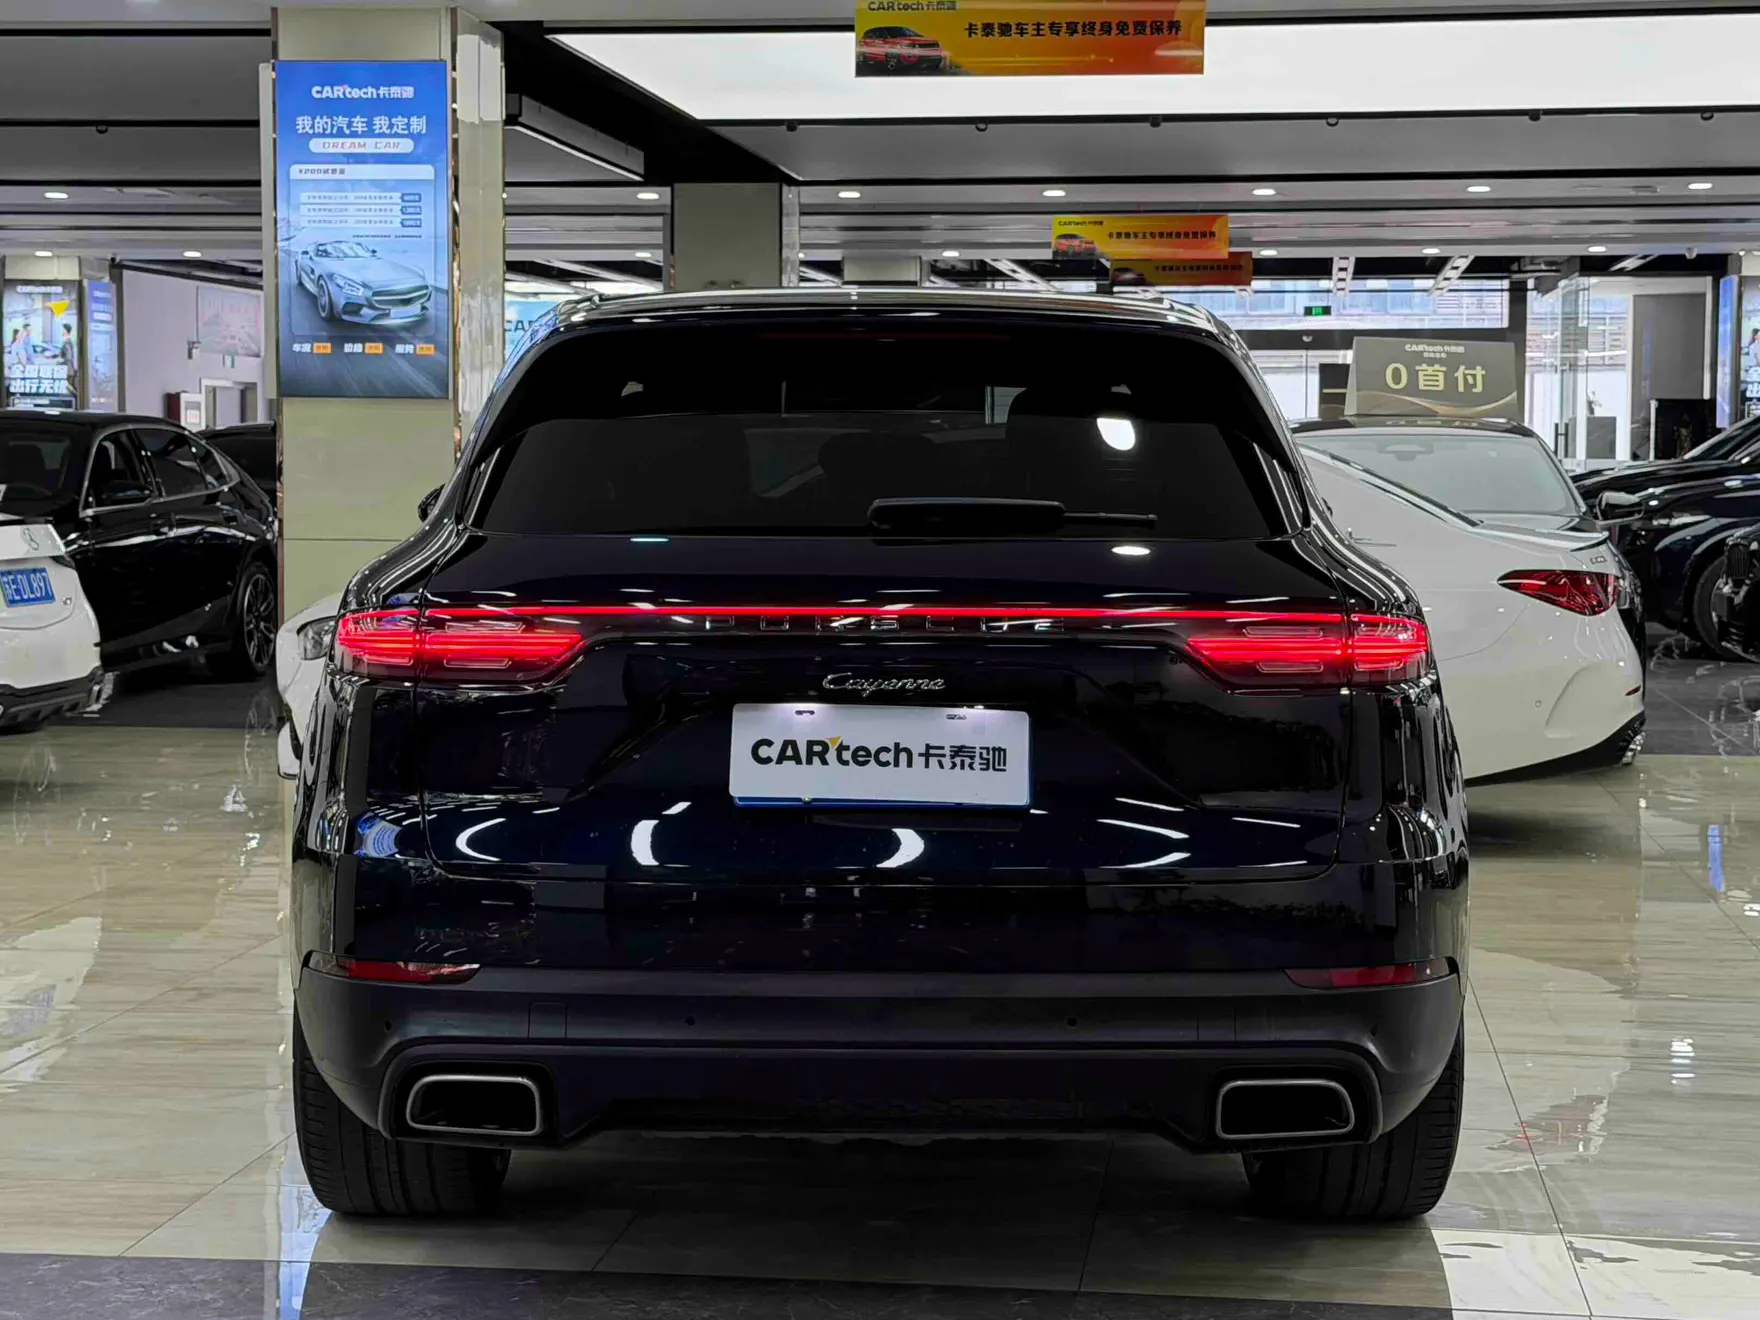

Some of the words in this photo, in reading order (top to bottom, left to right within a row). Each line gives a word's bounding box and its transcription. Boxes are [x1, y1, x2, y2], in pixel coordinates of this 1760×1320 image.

[963, 20, 1183, 38] 卡泰驰车主专享终身免费保养
[311, 85, 377, 99] CARtech
[295, 115, 368, 135] 我的汽车
[372, 115, 427, 135] 我定制
[322, 141, 367, 149] DREAM
[374, 141, 401, 149] CAR
[1385, 362, 1487, 393] 0首付
[822, 672, 947, 697] Cayenne
[750, 736, 913, 769] CARtech
[918, 742, 1008, 773] 卡泰驰
